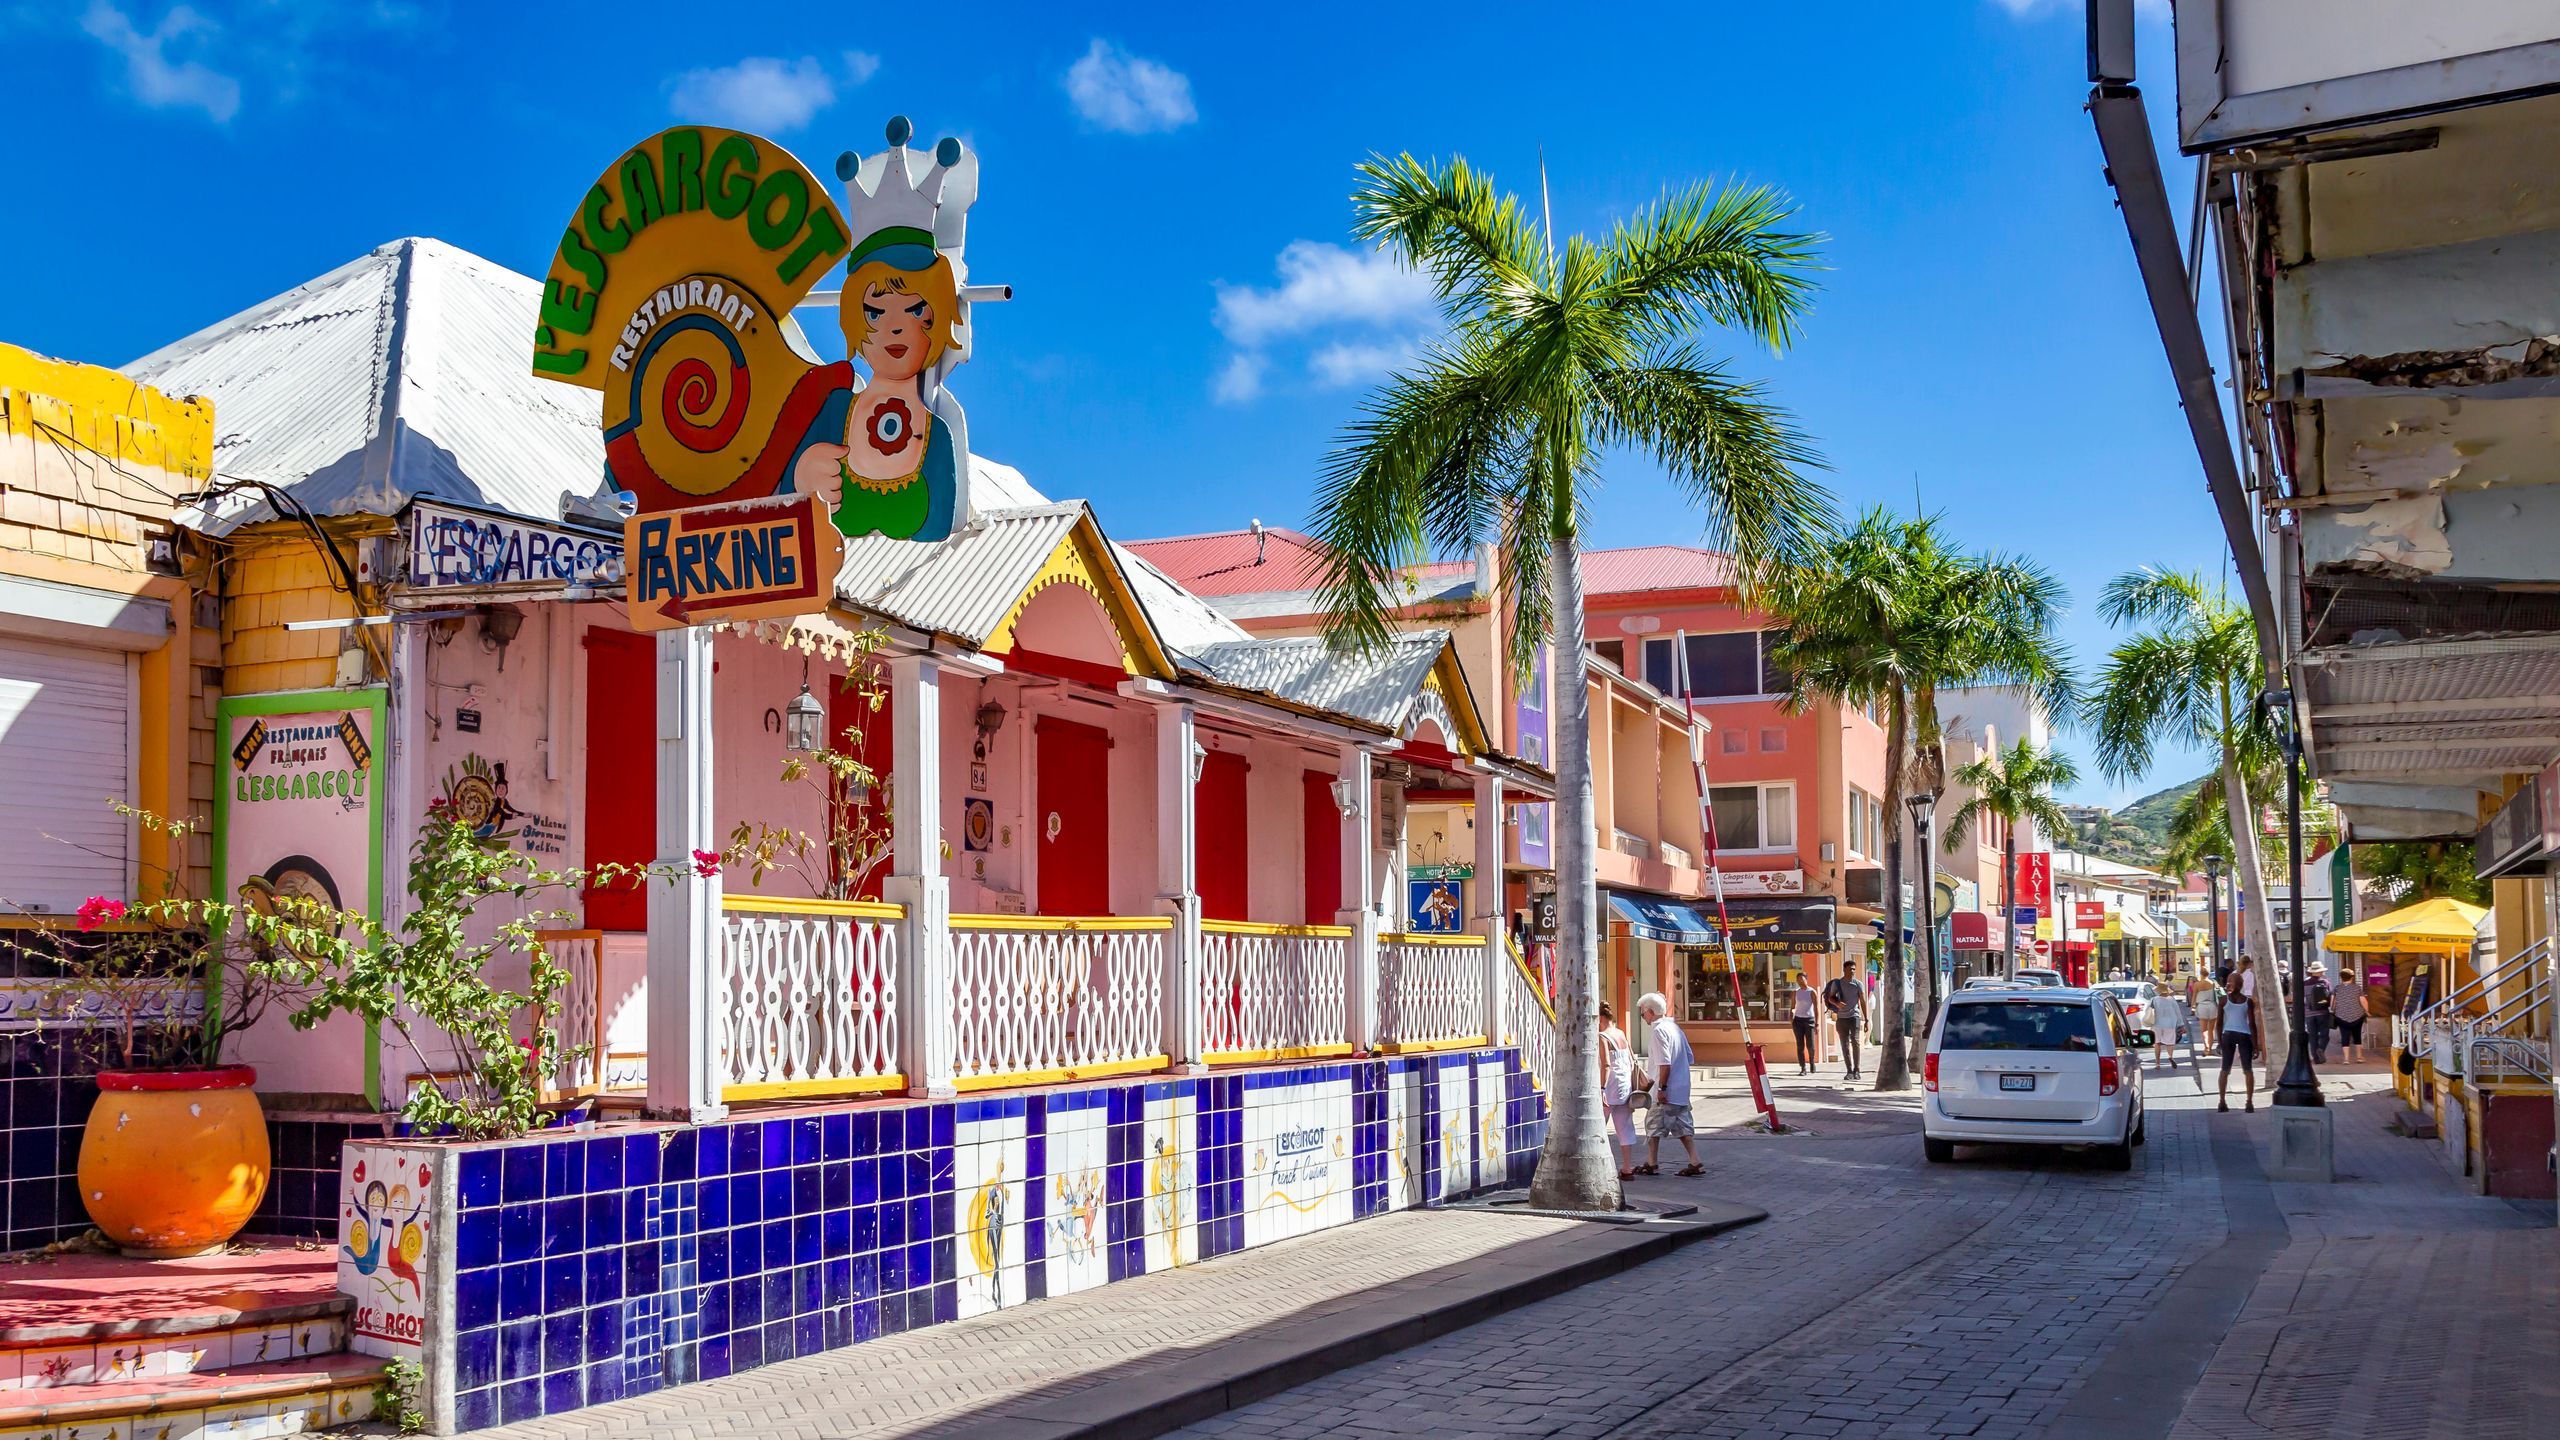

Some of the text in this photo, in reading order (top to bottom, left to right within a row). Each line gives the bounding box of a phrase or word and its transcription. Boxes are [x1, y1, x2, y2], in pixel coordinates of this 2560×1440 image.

[533, 128, 851, 376] L'ESCARGOT
[609, 279, 756, 373] RESTAURANT
[262, 724, 342, 744] RESTAURANT
[237, 769, 367, 803] L'ESCARGOT
[973, 769, 985, 785] 84
[1795, 942, 1824, 951] GUESS
[1271, 1159, 1299, 1186] French
